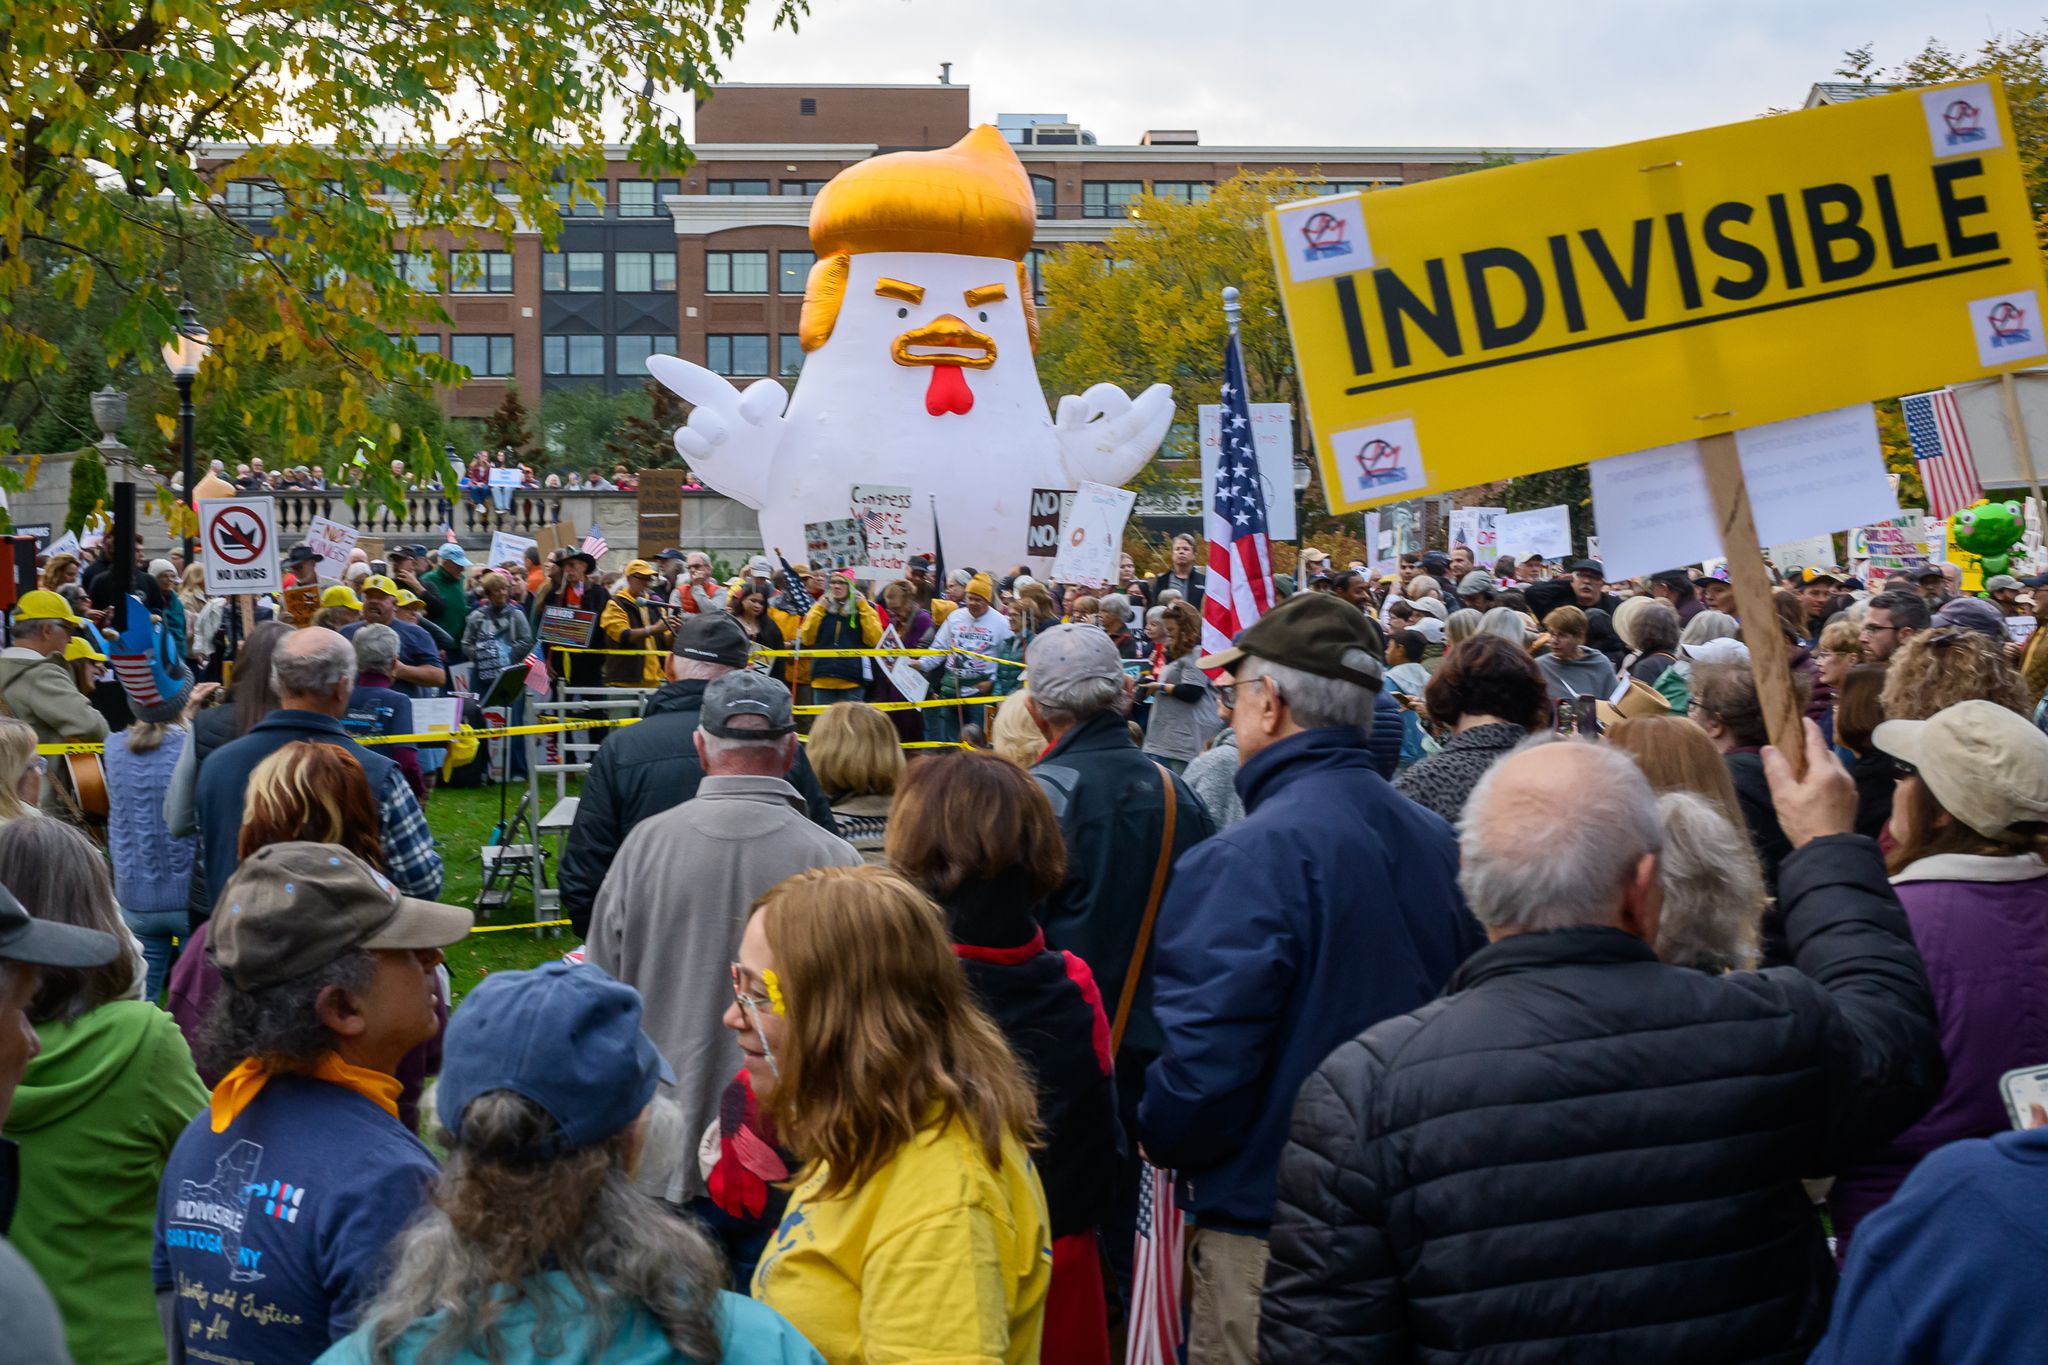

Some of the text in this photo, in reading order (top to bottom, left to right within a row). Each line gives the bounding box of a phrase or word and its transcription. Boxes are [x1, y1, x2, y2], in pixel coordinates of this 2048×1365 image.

[1335, 158, 2000, 377] INDIVISIBLE
[851, 486, 912, 508] Congress
[216, 567, 268, 581] NO KINGS
[869, 554, 908, 569] ictator
[176, 1200, 244, 1233] INDIVISIBLE
[165, 1228, 263, 1269] SARATOGA NY
[239, 1293, 303, 1325] Justice
[206, 1313, 230, 1340] All
